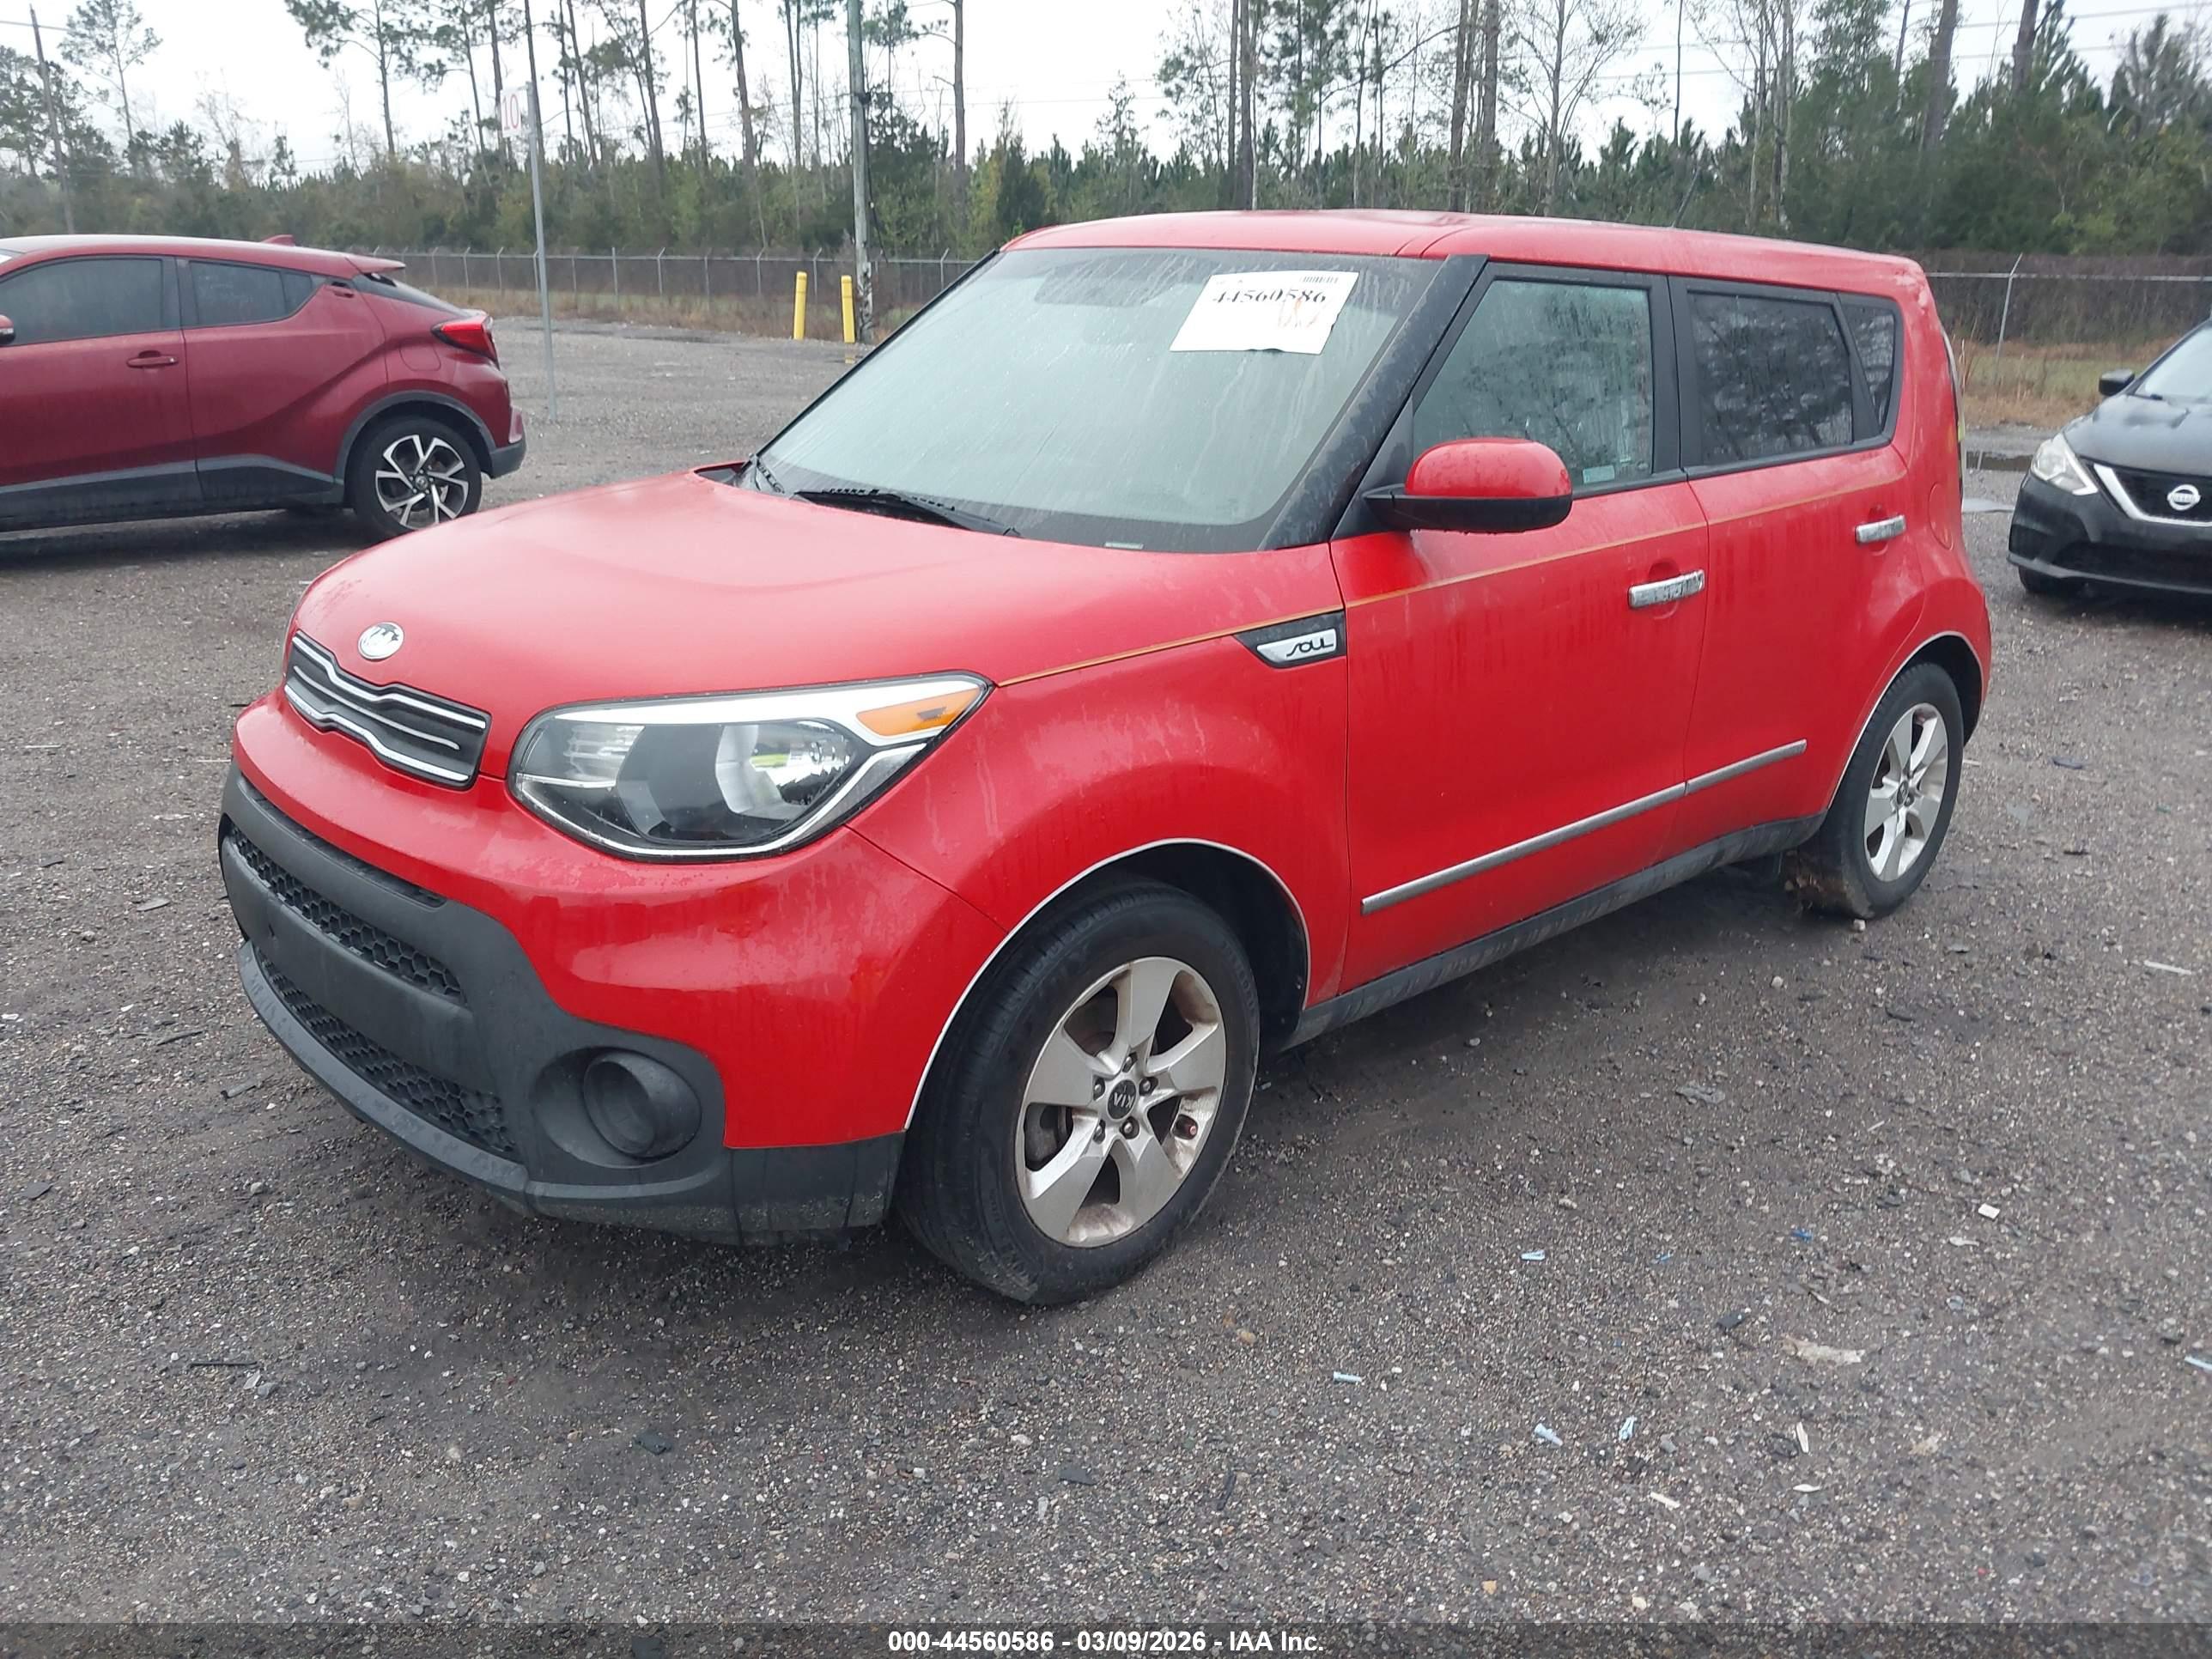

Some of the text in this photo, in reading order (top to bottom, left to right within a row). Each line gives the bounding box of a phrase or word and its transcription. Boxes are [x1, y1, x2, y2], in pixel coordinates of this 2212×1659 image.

[502, 94, 520, 130] 10
[1212, 289, 1327, 303] 44560586
[1286, 637, 1334, 657] SOUL
[1114, 1091, 1134, 1109] KIA
